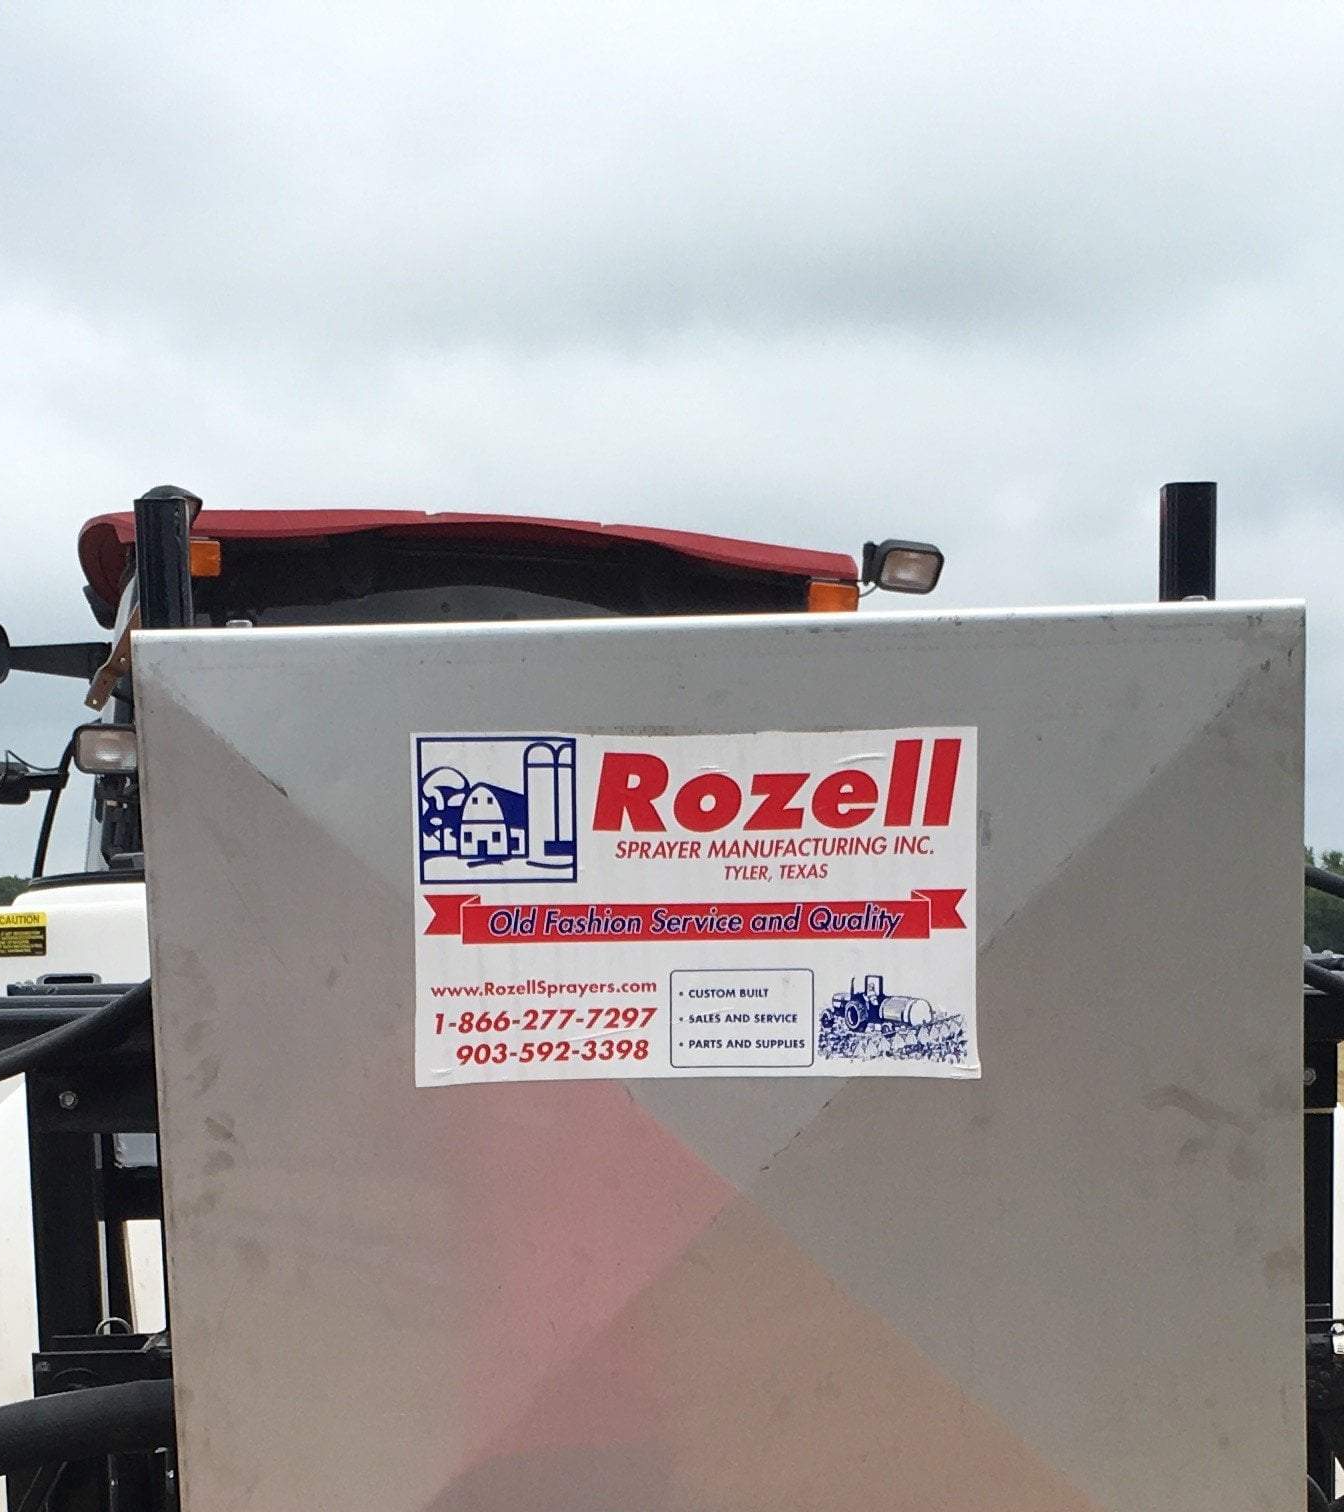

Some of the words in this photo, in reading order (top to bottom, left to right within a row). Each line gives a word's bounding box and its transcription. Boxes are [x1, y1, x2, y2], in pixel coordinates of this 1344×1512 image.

[591, 737, 962, 833] Rozell
[615, 840, 701, 859] SPRAYER
[707, 836, 887, 858] MANUFACTURING
[894, 836, 935, 855] INC.
[724, 865, 773, 883] TYLER,
[779, 864, 829, 879] TEXAS
[489, 908, 536, 936] Old
[544, 907, 642, 935] Fashion
[651, 907, 742, 933] Service
[752, 905, 801, 932] and
[808, 902, 903, 939] Quality
[431, 979, 657, 998] www.RozellSprayers.com
[688, 988, 736, 999] CUSTOM
[739, 987, 769, 998] BUILT
[434, 1007, 658, 1035] 1-866-277-7297
[688, 1013, 721, 1024] SALES
[725, 1013, 751, 1023] AND
[754, 1013, 798, 1024] SERVICE
[456, 1039, 649, 1066] 903-592-3398
[688, 1039, 723, 1049] PARTS
[726, 1039, 752, 1049] AND
[755, 1038, 806, 1049] SUPPLIES
